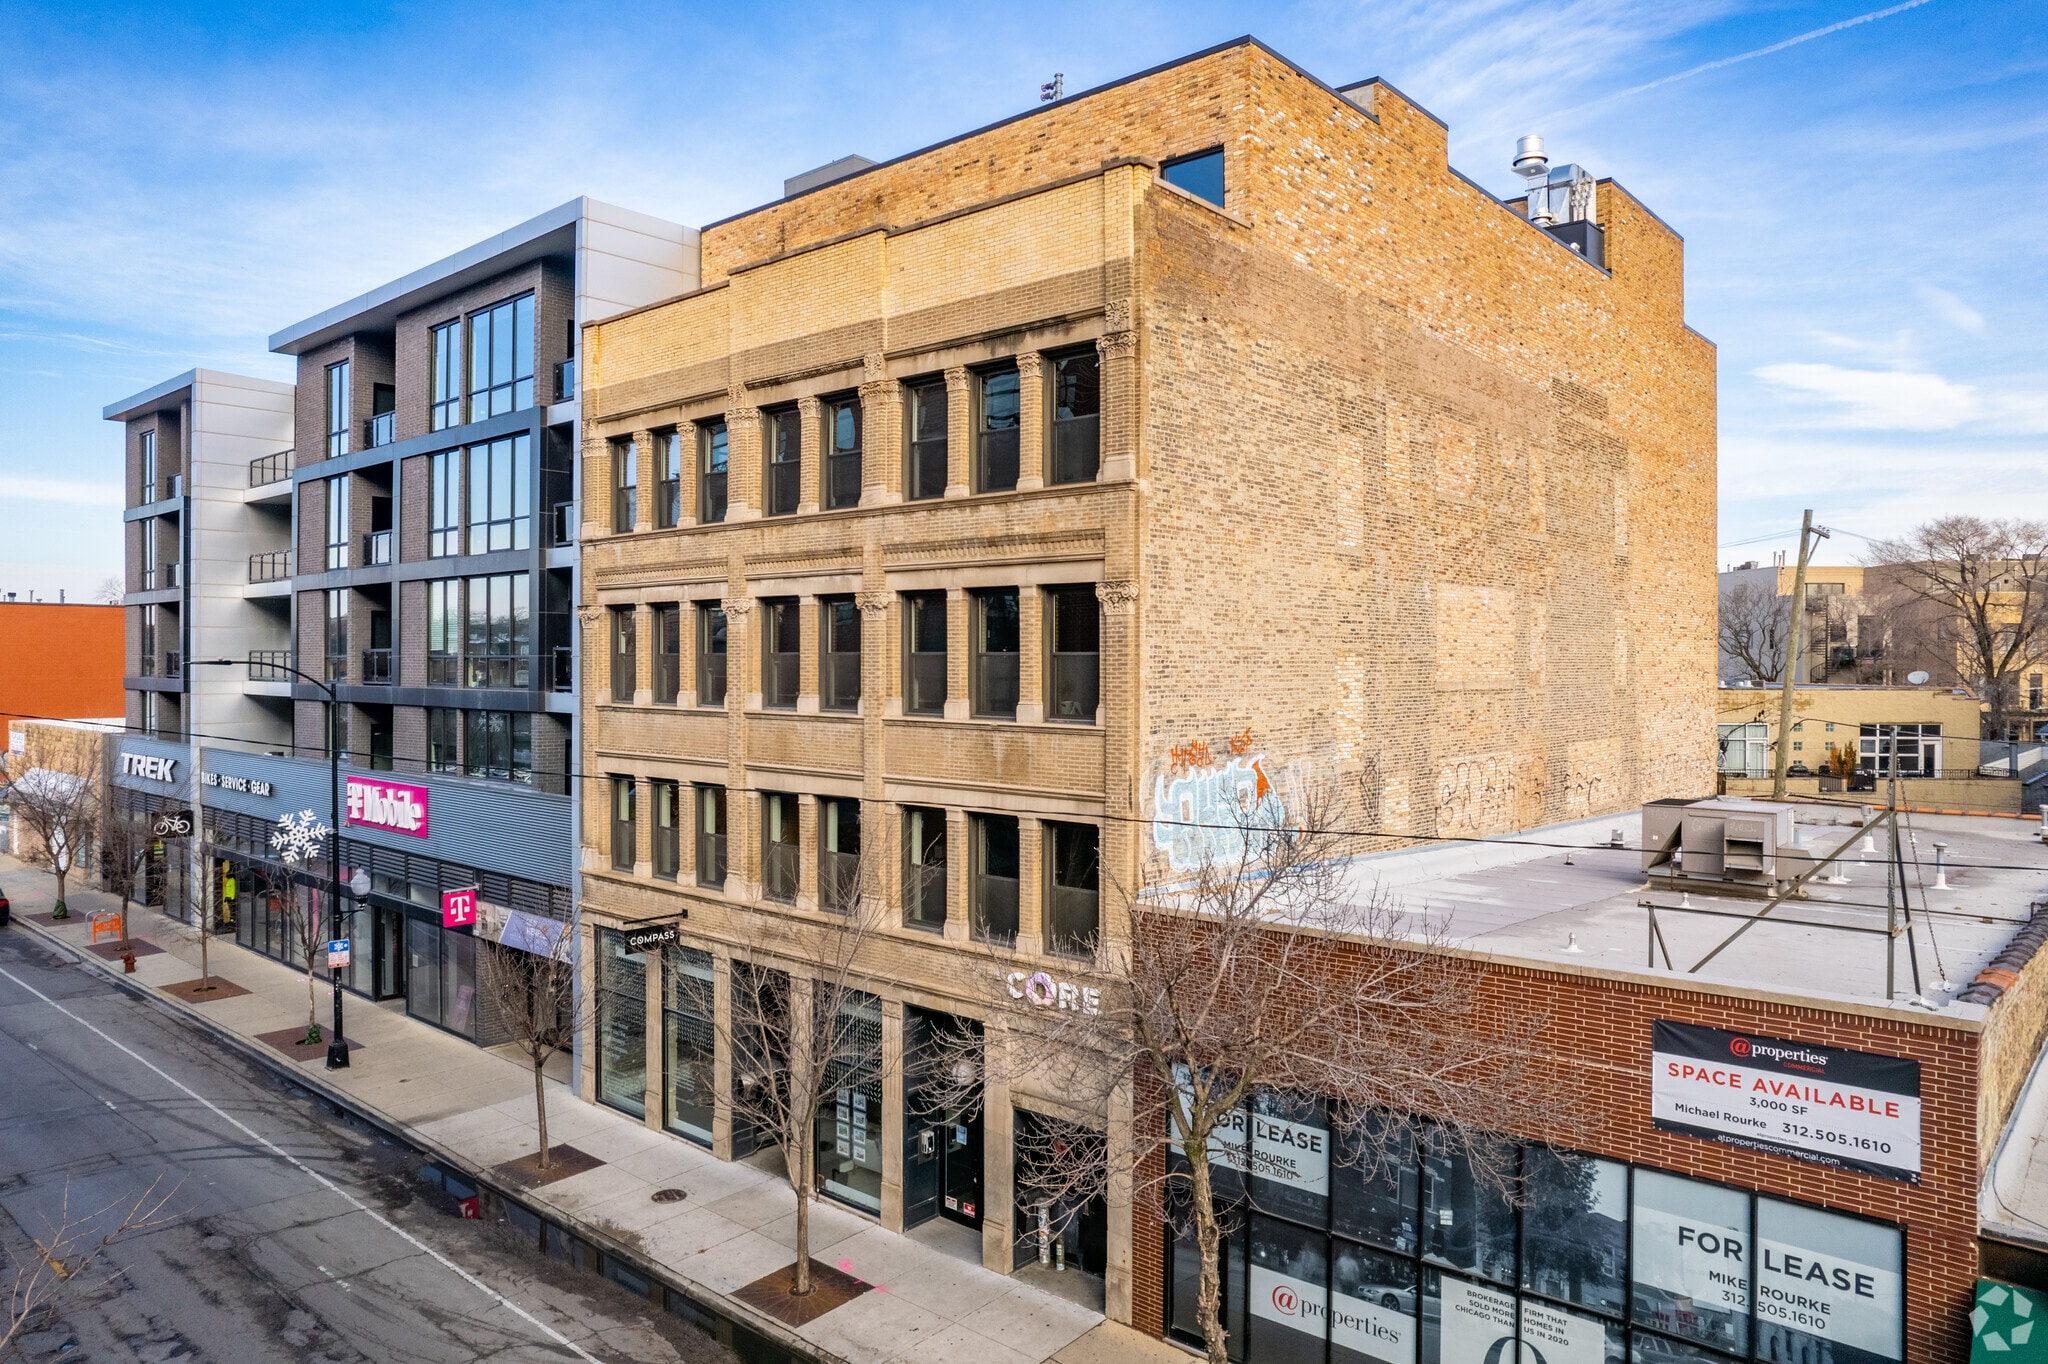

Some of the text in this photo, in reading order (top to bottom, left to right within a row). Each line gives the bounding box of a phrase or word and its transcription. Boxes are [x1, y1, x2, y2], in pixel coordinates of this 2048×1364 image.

[120, 752, 177, 783] TREK
[201, 771, 270, 797] BIKES SERVICE GEAR
[450, 895, 471, 922] T
[630, 930, 675, 946] COMPASS
[1006, 972, 1101, 1016] CORE
[1729, 1037, 1828, 1066] @properties
[1783, 1061, 1826, 1075] COMMERCIAL
[1668, 1062, 1900, 1119] SPACE AVAILABLE
[1749, 1097, 1809, 1116] 3,000 SF
[1256, 1121, 1322, 1154] LEASE
[1675, 1103, 1892, 1154] Michael Rourke 312.505.1610
[1254, 1149, 1297, 1169] ROURKE
[1718, 1133, 1841, 1166] atpropertiescommercial.com
[1678, 1225, 1875, 1299] FOR LEASE
[1466, 1289, 1568, 1327] BROKERAGE FIRM THAT
[1708, 1270, 1831, 1316] MIKE ROURKE
[1455, 1304, 1570, 1347] CHICAGO THAN US IN 2020
[1468, 1299, 1565, 1336] SOLD MORE HOMES IN
